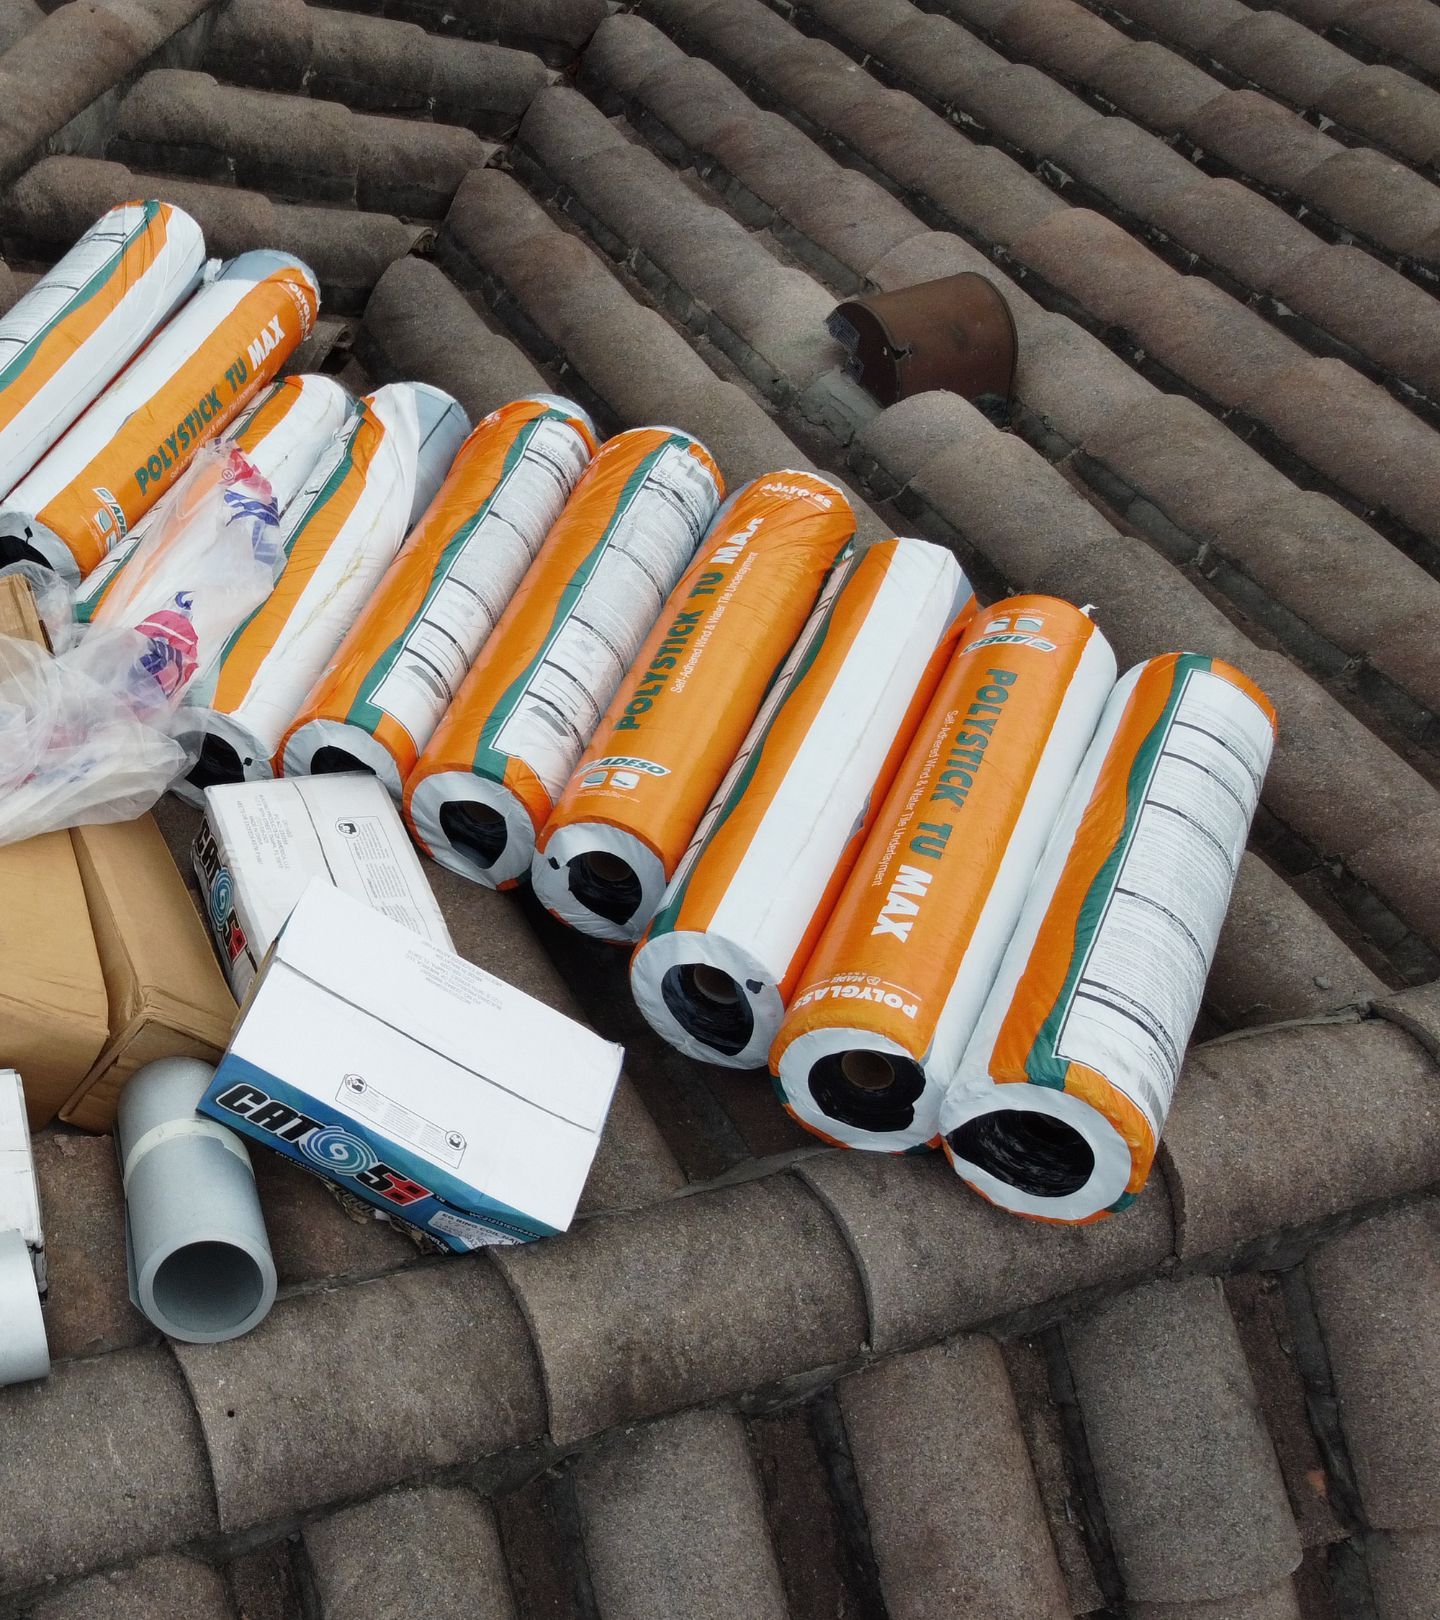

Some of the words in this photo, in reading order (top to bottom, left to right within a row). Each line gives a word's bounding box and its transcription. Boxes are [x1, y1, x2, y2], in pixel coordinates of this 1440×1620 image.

[134, 391, 224, 496] POLYSTICK
[226, 357, 248, 395] TU
[247, 314, 287, 373] MAX
[111, 504, 128, 537] ADE
[695, 627, 713, 648] Wind
[707, 602, 727, 626] Water
[724, 547, 759, 596] Underlayment
[616, 610, 704, 731] POLYSTICK
[693, 571, 723, 599] TU
[930, 669, 1018, 806] POLYSTICK
[598, 758, 666, 777] ADESO
[918, 756, 937, 780] Wind
[903, 784, 924, 813] Water
[915, 822, 952, 858] TU
[870, 863, 933, 944] MAX
[792, 985, 918, 1019] POLYGLASS
[216, 1082, 320, 1144] CAT
